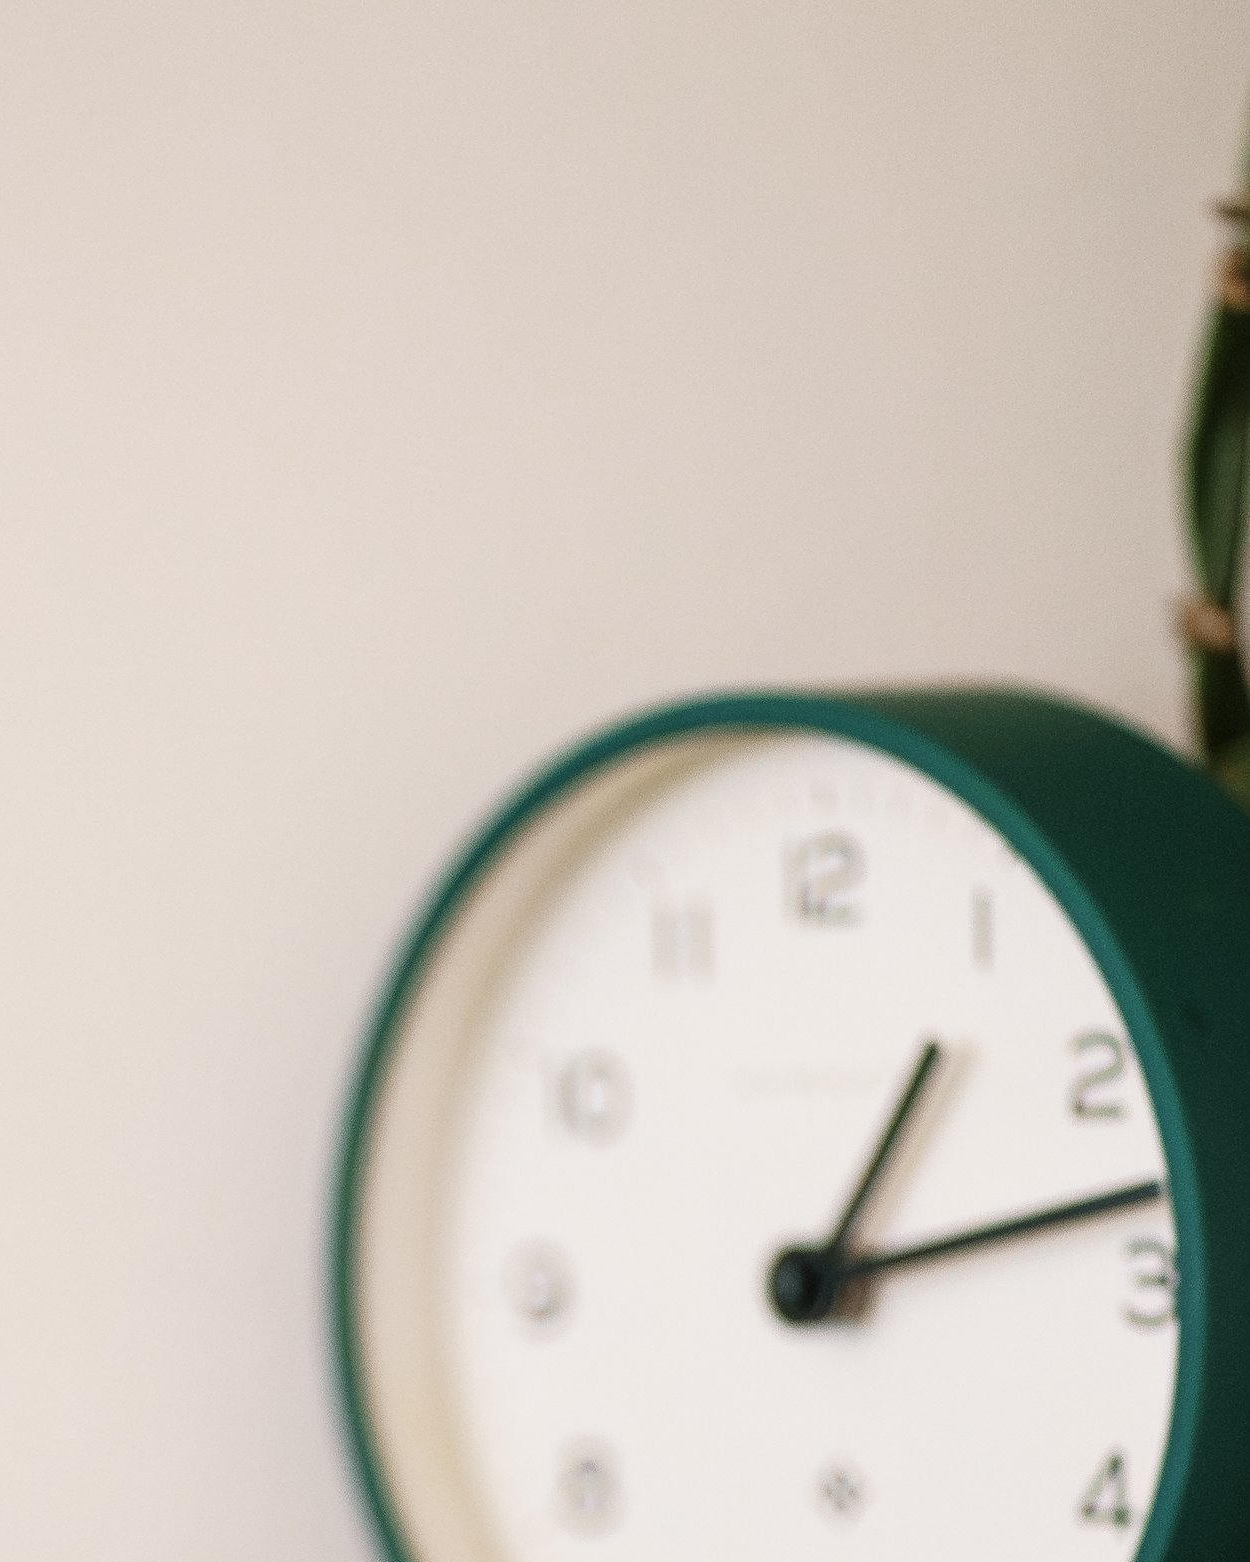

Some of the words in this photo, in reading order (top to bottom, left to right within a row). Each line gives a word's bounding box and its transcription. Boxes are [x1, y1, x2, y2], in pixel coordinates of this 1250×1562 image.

[784, 829, 866, 926] 12
[652, 896, 712, 978] 11
[972, 887, 991, 971] 1
[1069, 1032, 1128, 1120] 2
[1123, 1241, 1177, 1327] 3
[1079, 1448, 1132, 1529] 4
